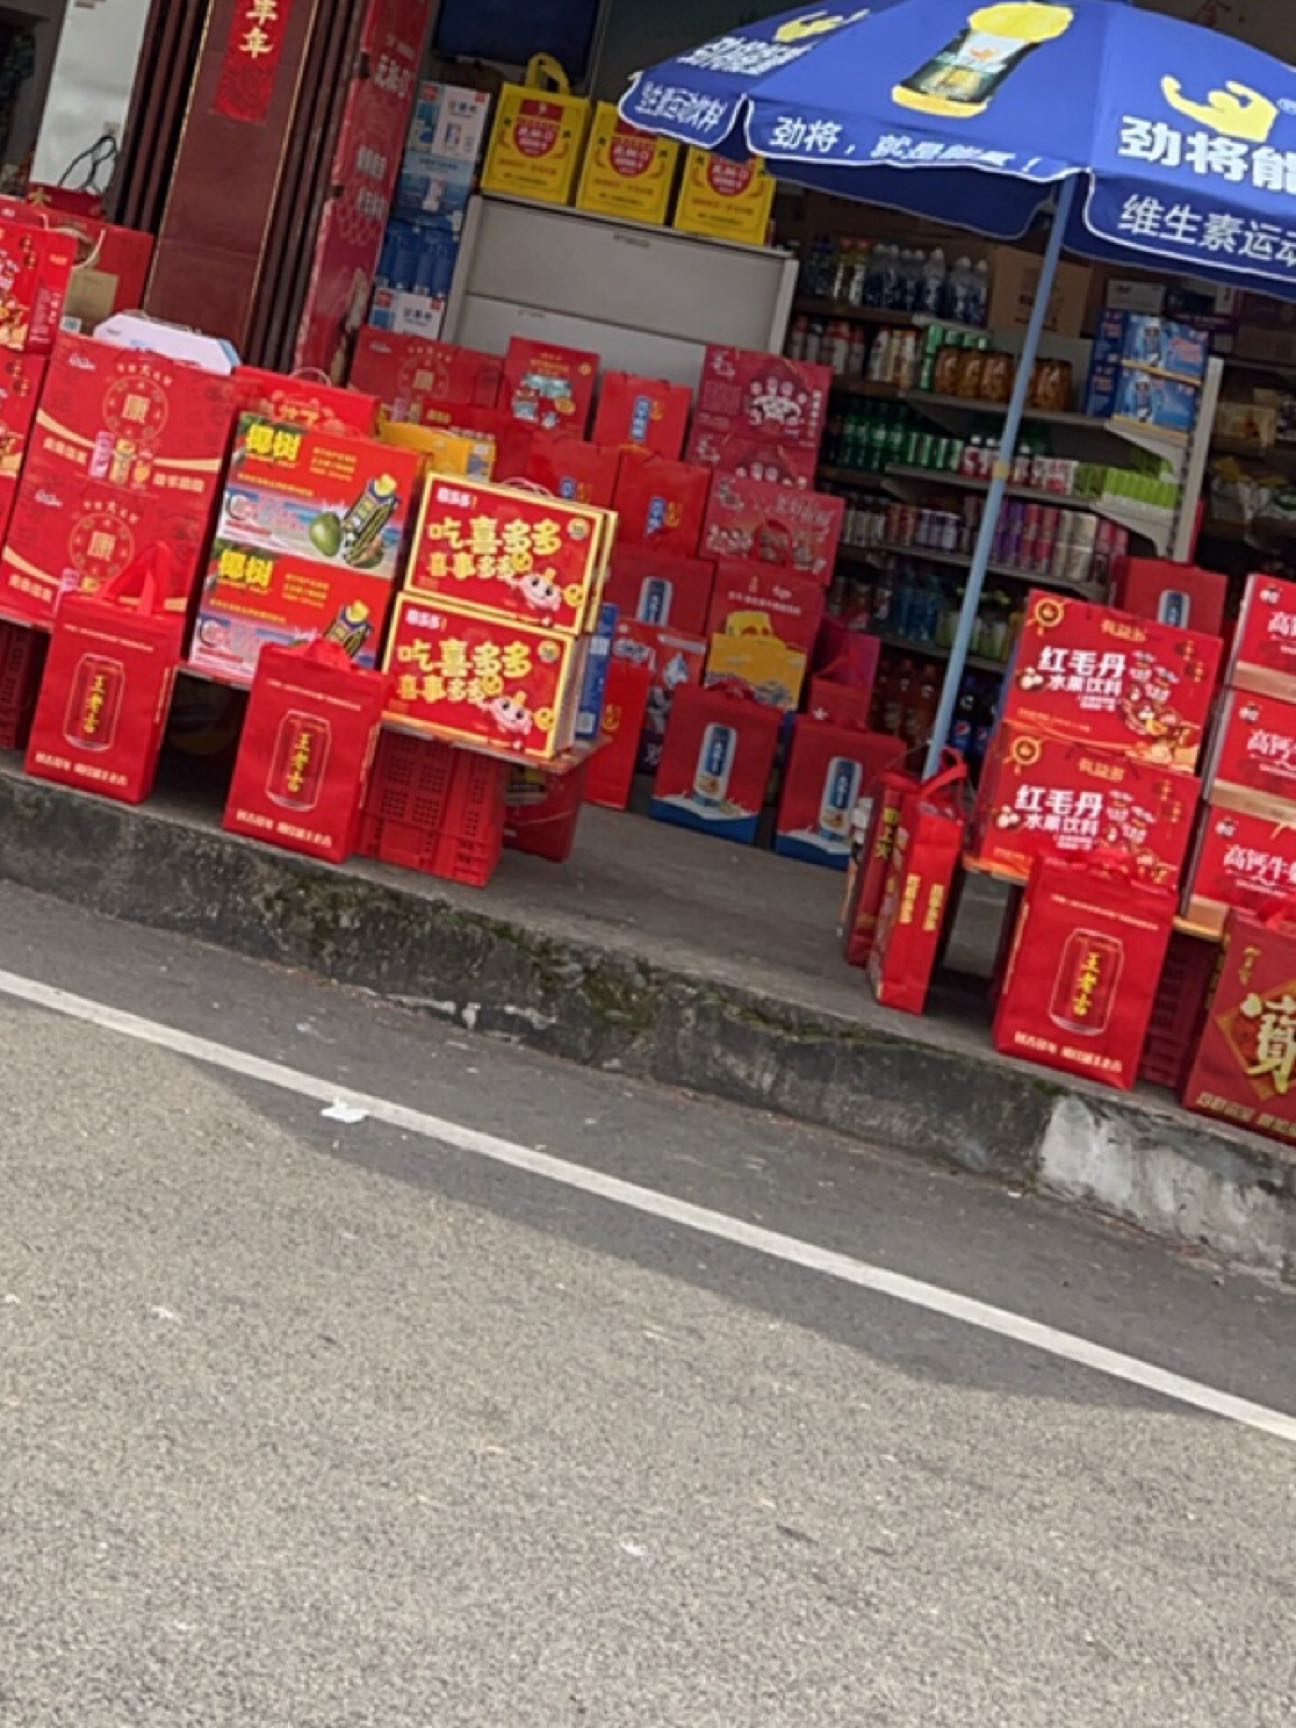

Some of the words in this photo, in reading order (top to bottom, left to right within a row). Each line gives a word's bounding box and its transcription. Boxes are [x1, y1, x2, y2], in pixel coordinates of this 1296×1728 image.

[246, 423, 302, 461] 椰树
[428, 515, 562, 556] 吃喜多多
[218, 549, 274, 588] 椰树
[398, 638, 531, 678] 吃喜多多
[1038, 645, 1126, 679] 红毛丹
[1048, 674, 1123, 697] 水果饮料
[1247, 731, 1296, 765] 高钙
[1014, 783, 1104, 818] 红毛丹
[1024, 813, 1100, 837] 水果饮料
[1072, 952, 1101, 1015] 王老吉
